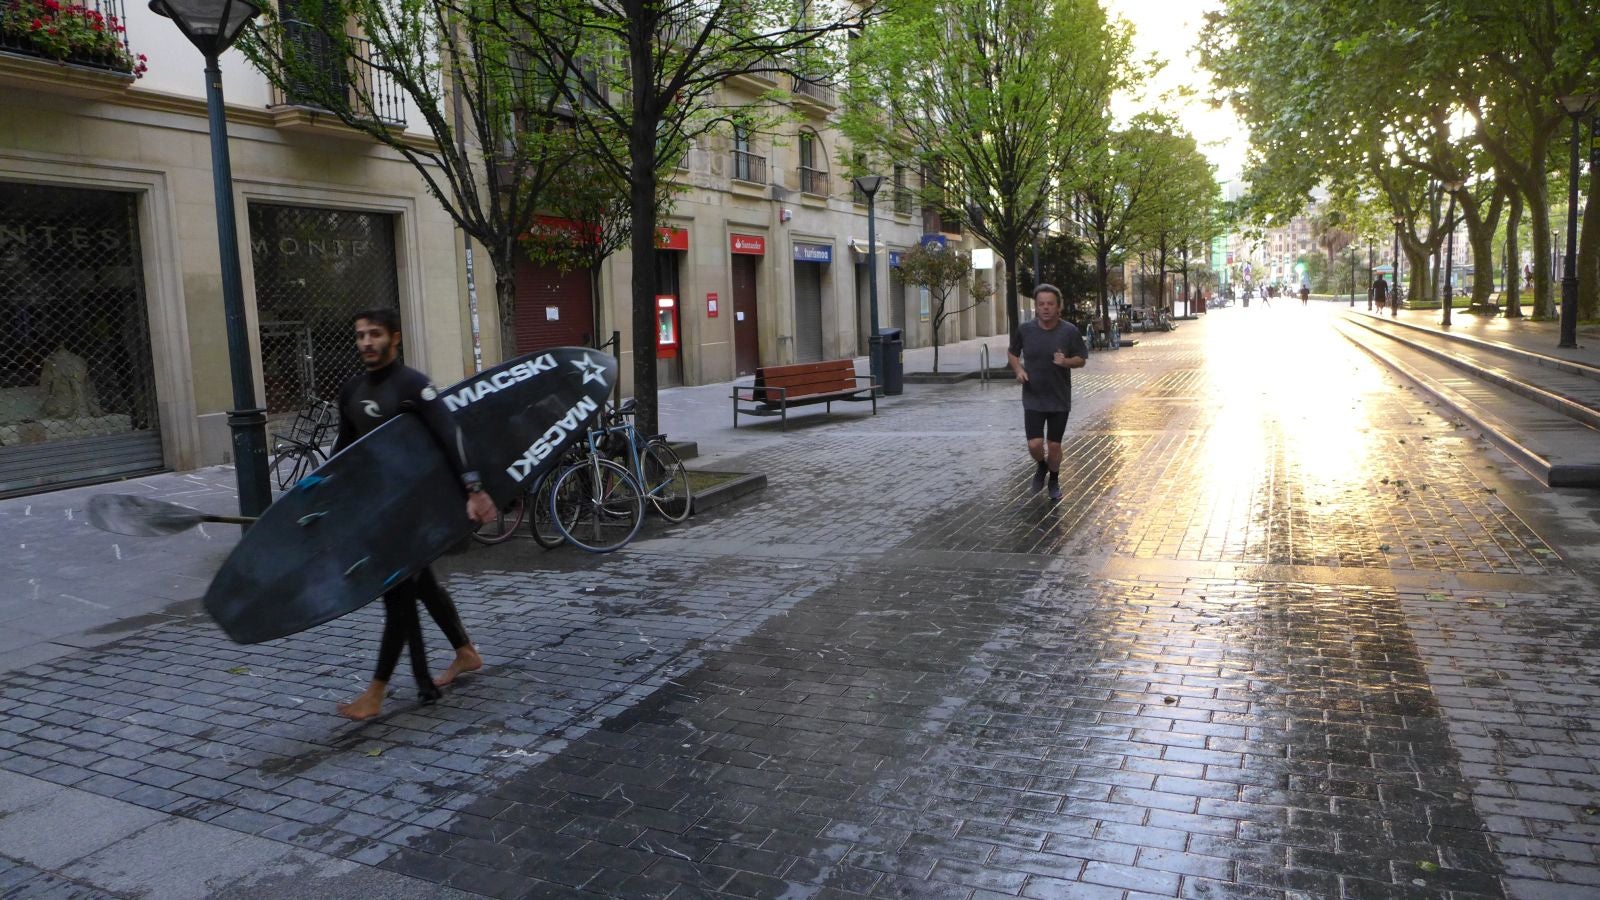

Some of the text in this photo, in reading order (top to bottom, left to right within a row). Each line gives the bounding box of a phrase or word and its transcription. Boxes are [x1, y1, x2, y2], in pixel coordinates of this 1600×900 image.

[741, 240, 761, 250] Santander
[442, 353, 559, 412] MACSKI
[505, 395, 599, 483] MACSKI
